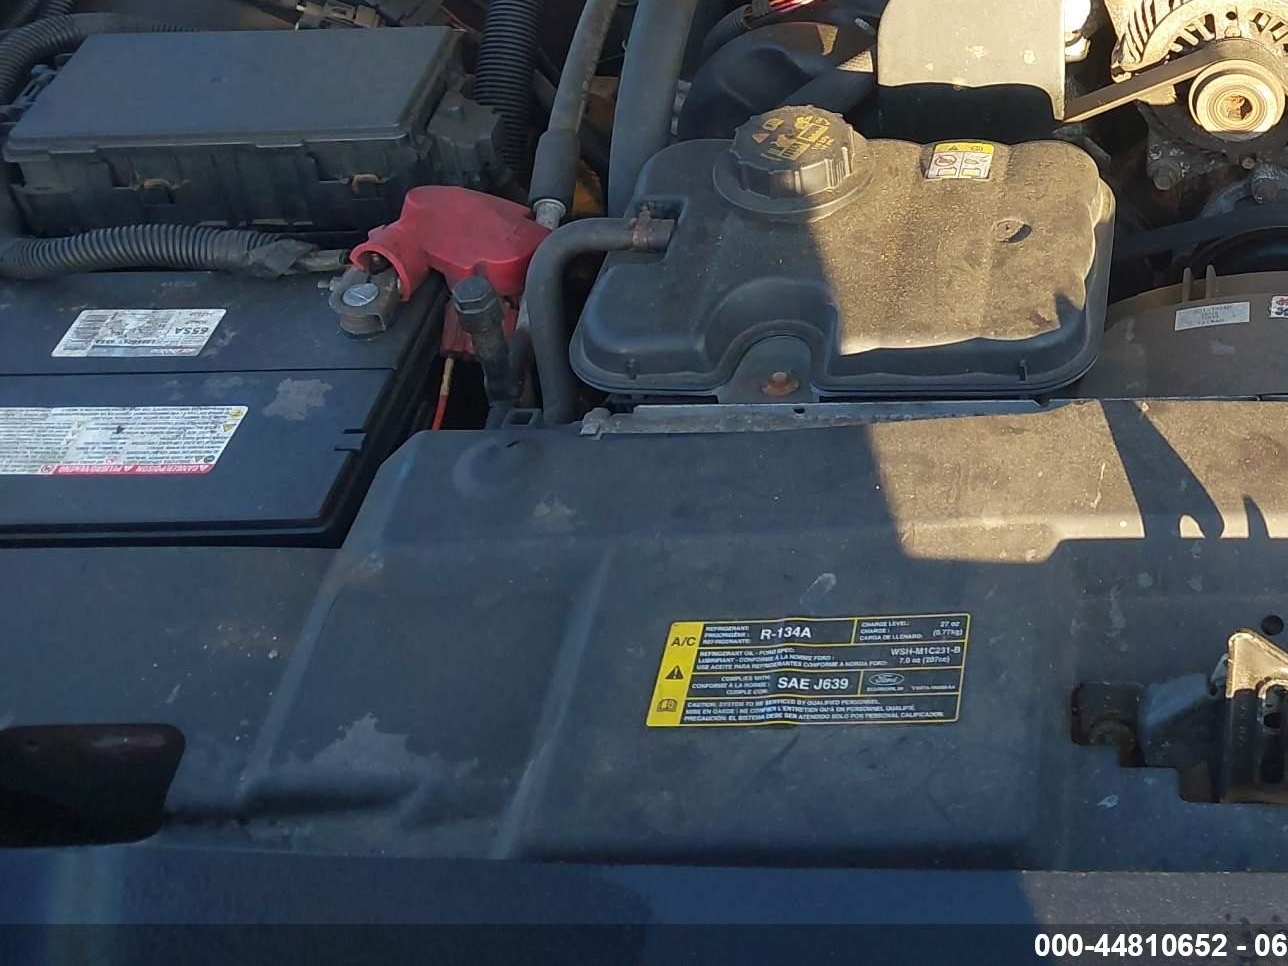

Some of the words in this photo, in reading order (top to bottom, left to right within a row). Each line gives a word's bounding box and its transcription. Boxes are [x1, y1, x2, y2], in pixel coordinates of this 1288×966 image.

[760, 626, 812, 641] R-134A
[671, 636, 697, 647] A/C
[890, 646, 961, 656] WSH-M1C231-B
[777, 677, 810, 690] SAE
[813, 678, 849, 690] J639
